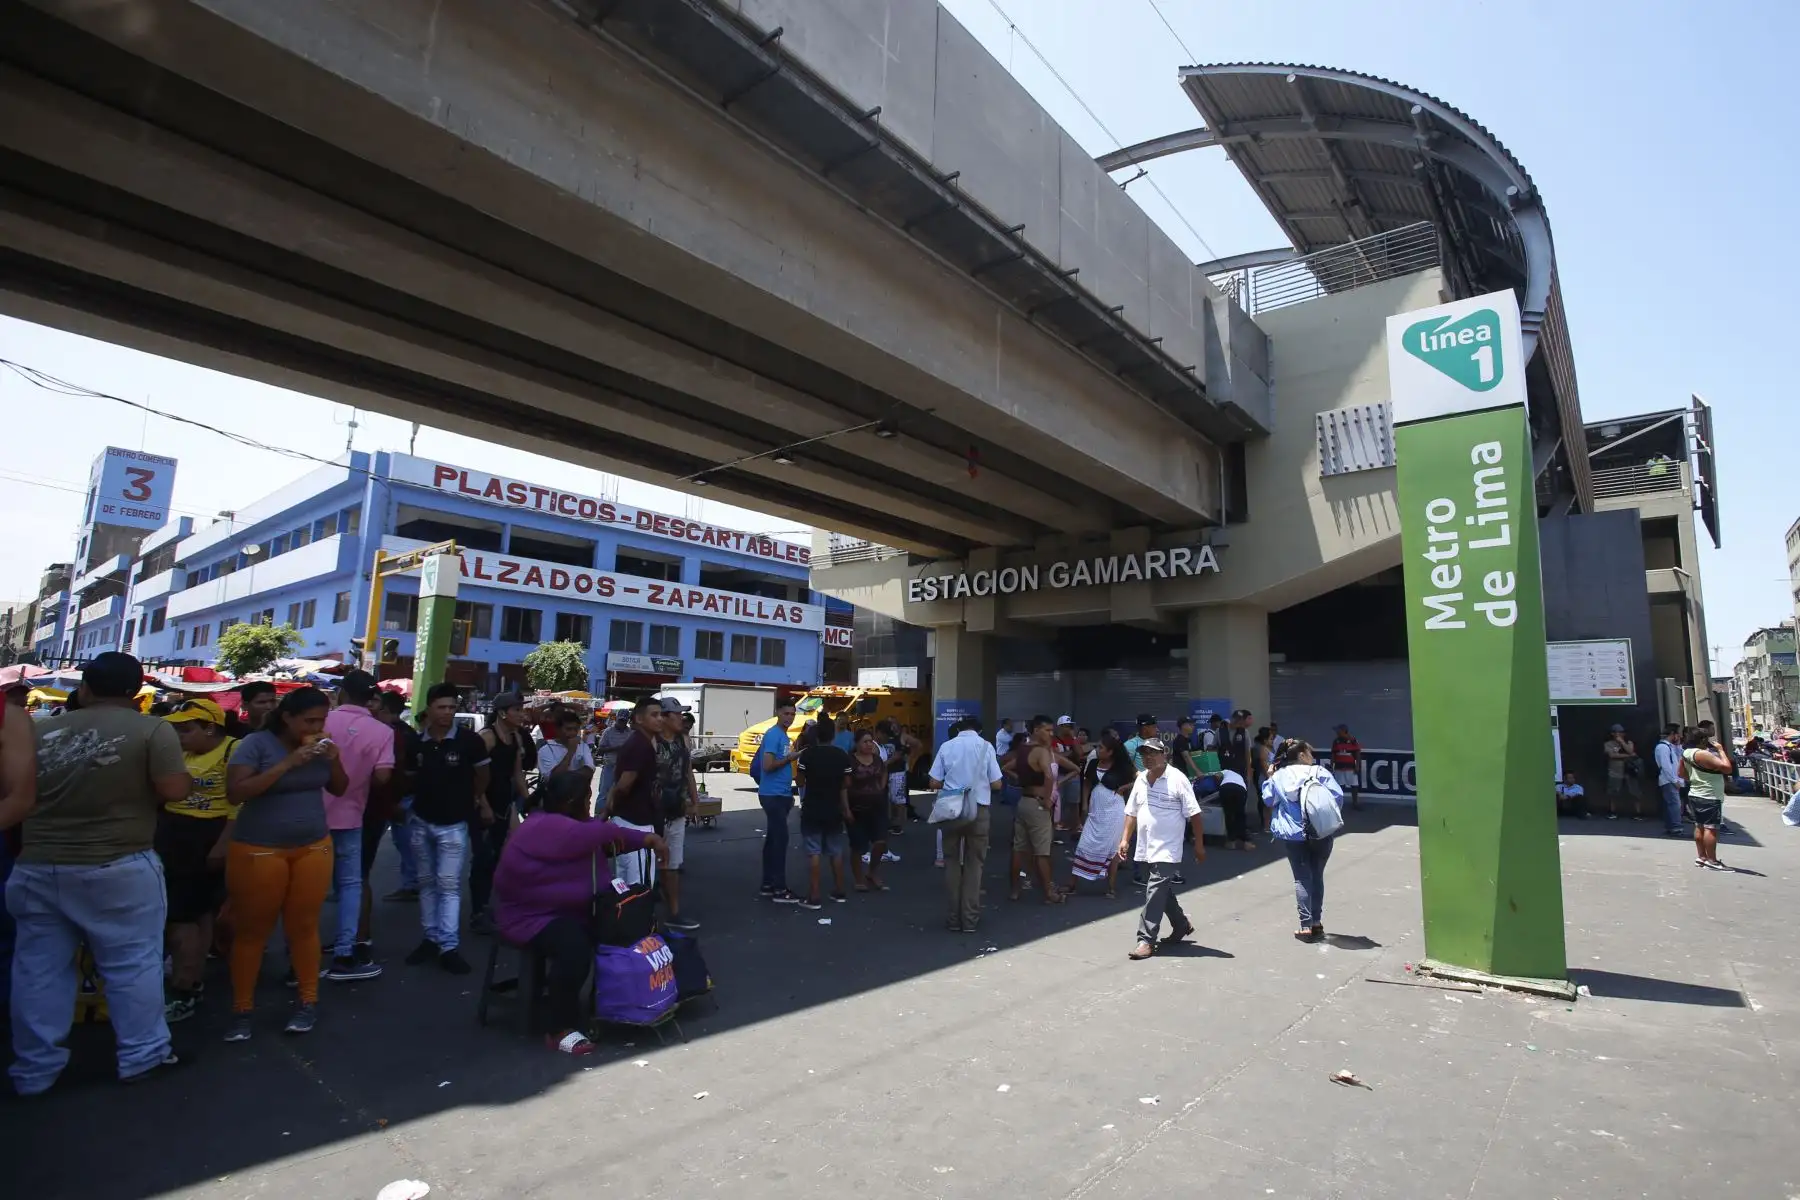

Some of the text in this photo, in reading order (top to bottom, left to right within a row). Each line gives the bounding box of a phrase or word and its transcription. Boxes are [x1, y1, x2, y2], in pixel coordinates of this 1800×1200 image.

[1470, 346, 1494, 383] 1
[107, 448, 137, 459] CENTRO
[122, 466, 155, 502] 3
[102, 504, 161, 520] DE FEBRERO
[1465, 440, 1518, 628] de Lima
[908, 544, 1221, 603] ESTACION GAMARRA
[1422, 497, 1467, 631] Metro
[647, 583, 803, 624] ZAPATILLAS
